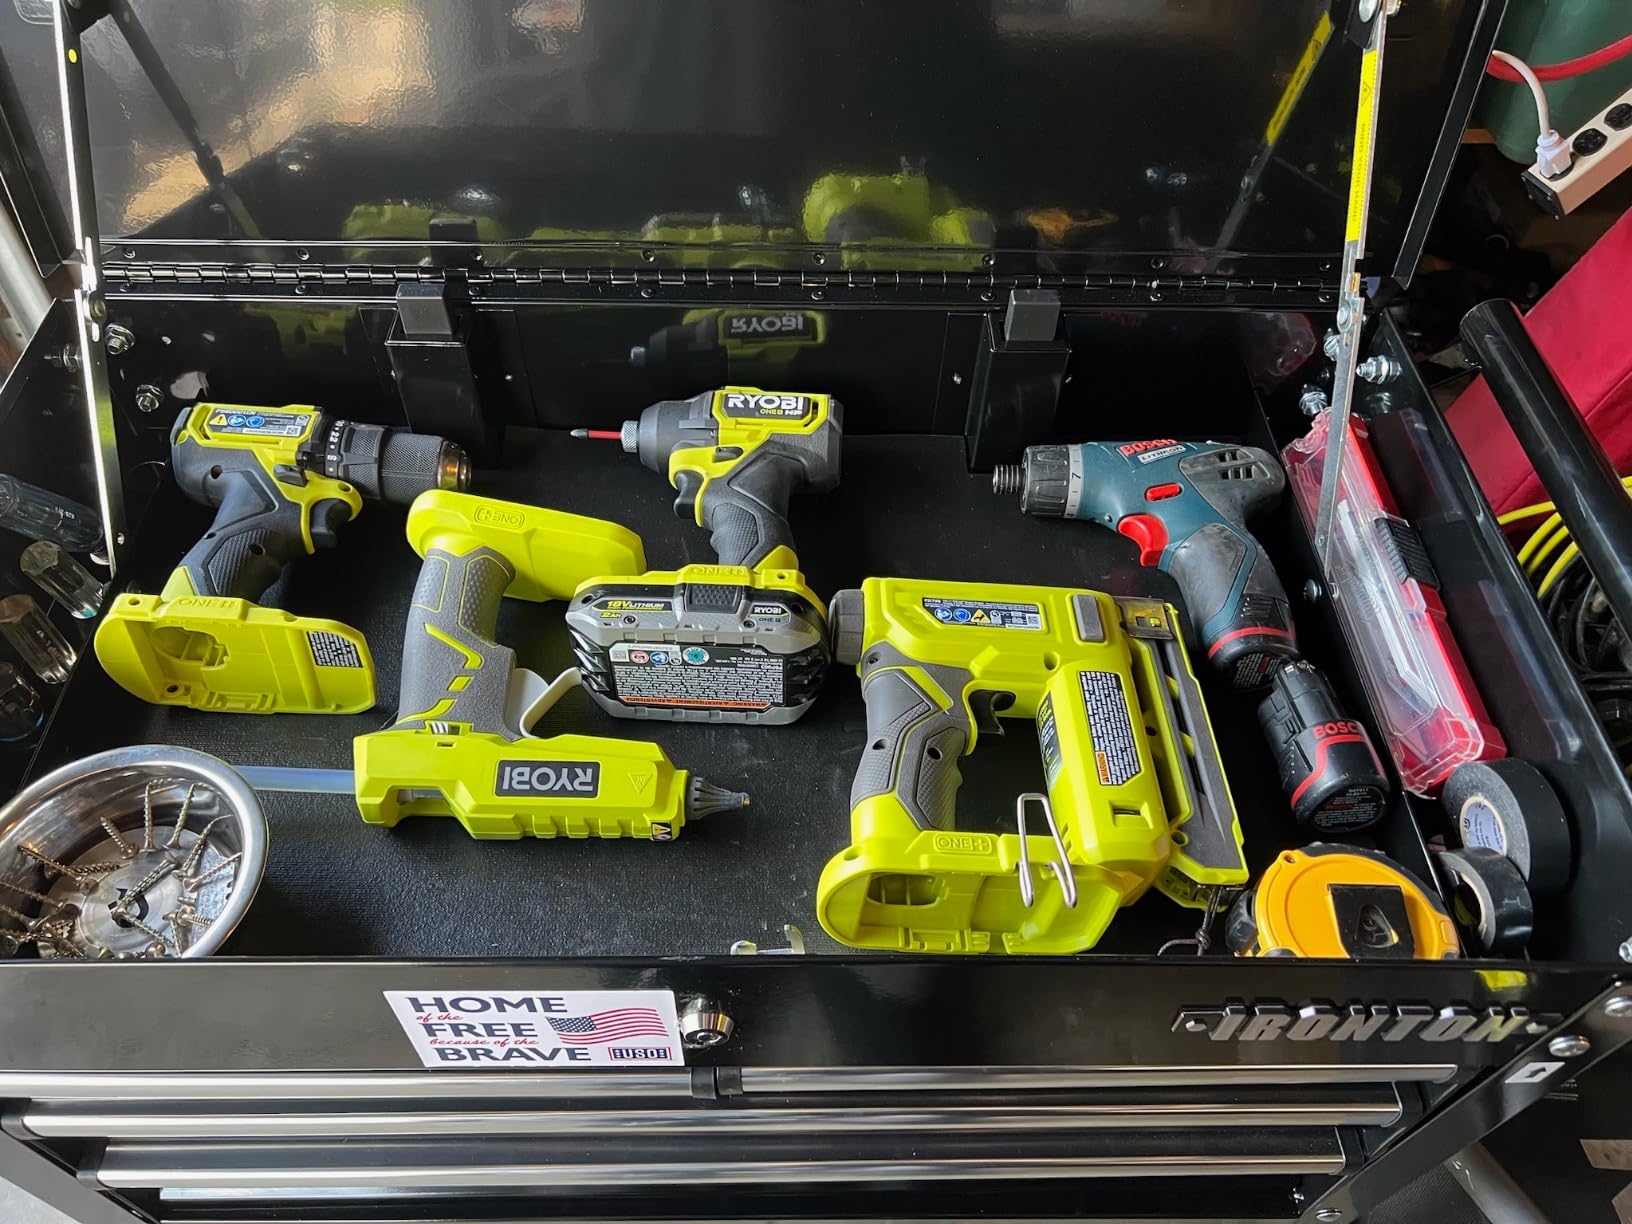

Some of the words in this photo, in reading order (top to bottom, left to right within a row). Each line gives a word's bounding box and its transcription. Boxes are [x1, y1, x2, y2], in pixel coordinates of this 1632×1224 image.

[727, 394, 804, 410] RYOBI
[329, 430, 340, 443] 22
[1120, 438, 1178, 457] BOSCH
[1072, 472, 1082, 480] 7
[753, 606, 782, 614] RYOBI
[1312, 721, 1360, 740] BOSC
[502, 767, 594, 791] RYOBI
[405, 997, 568, 1013] HOME
[415, 1013, 433, 1023] of
[437, 1012, 463, 1021] the
[1209, 1006, 1529, 1042] IRONTON
[418, 1022, 538, 1037] FREE
[429, 1038, 490, 1046] because
[492, 1038, 510, 1048] of
[513, 1037, 540, 1046] the
[432, 1047, 592, 1061] BRAVE
[622, 1049, 658, 1059] USO
